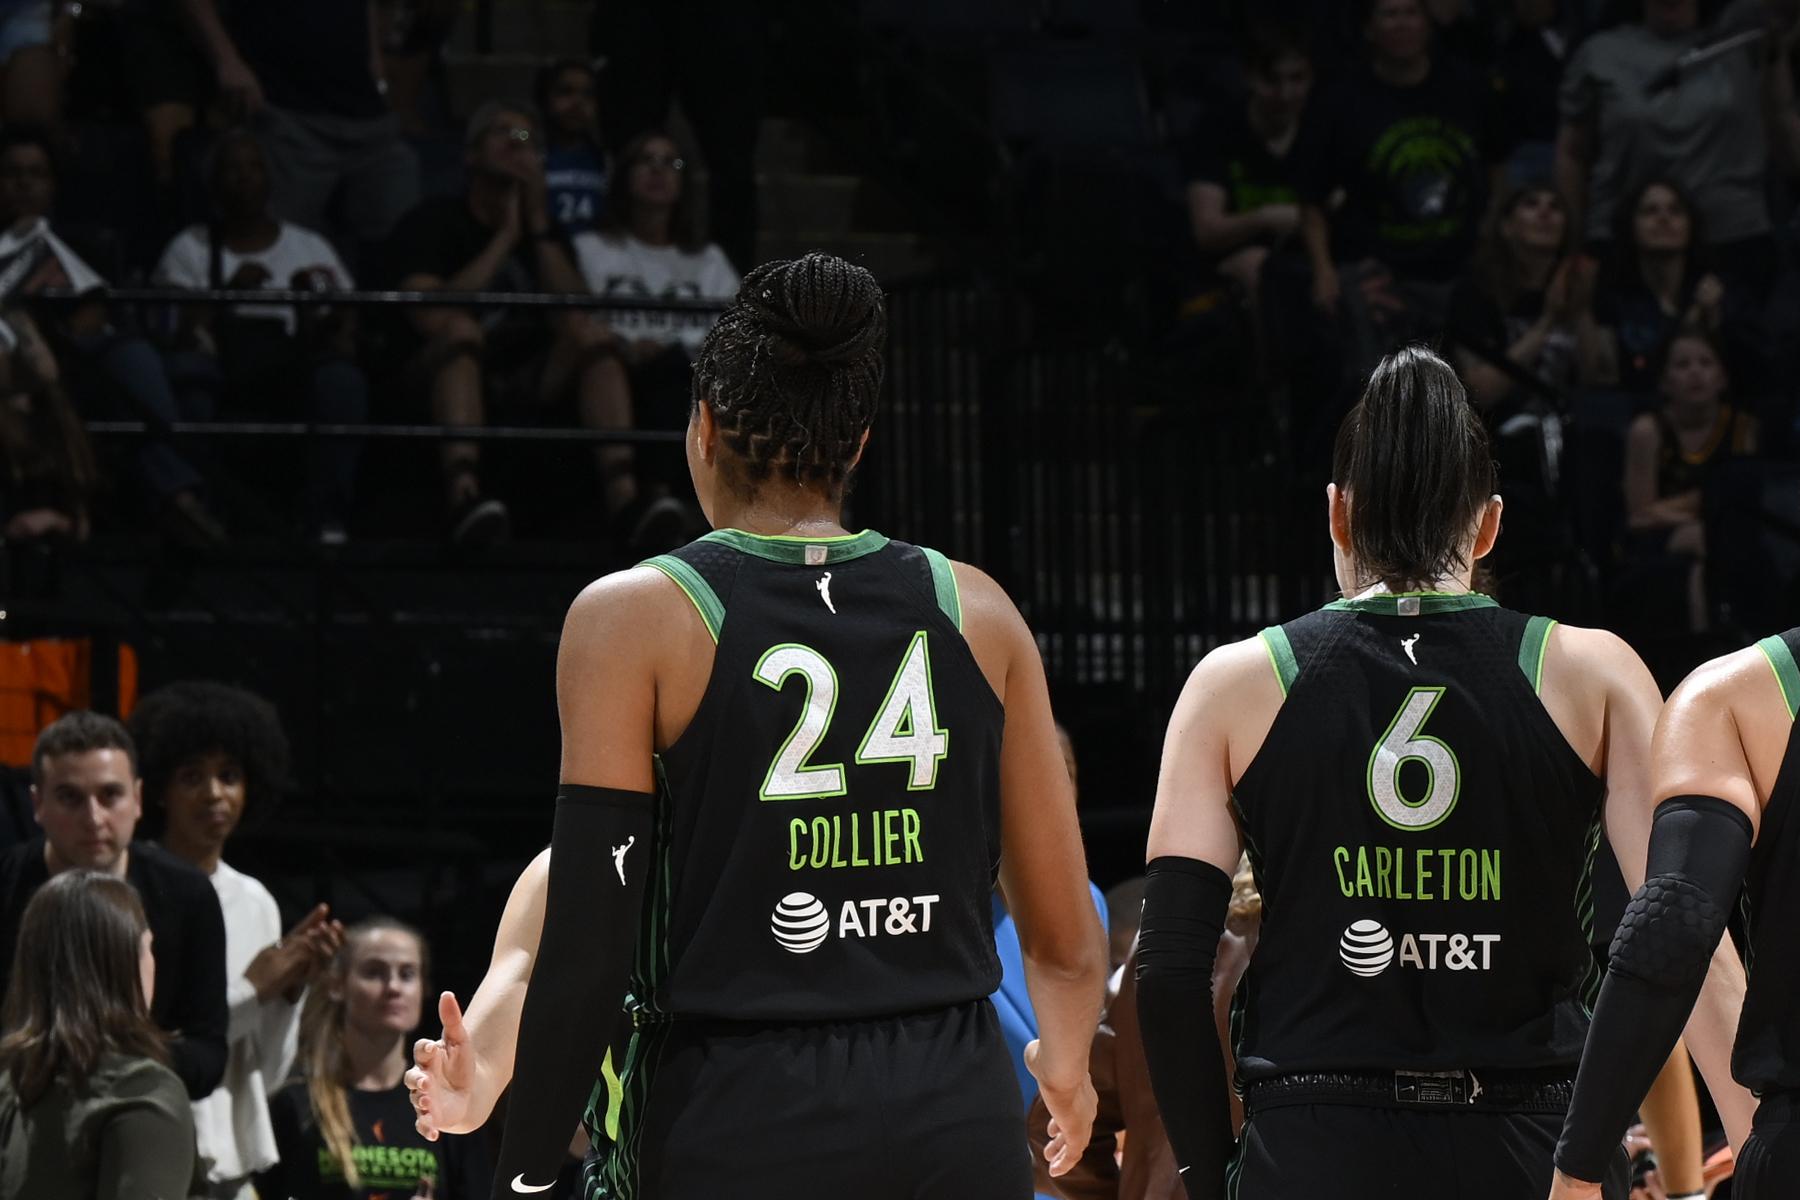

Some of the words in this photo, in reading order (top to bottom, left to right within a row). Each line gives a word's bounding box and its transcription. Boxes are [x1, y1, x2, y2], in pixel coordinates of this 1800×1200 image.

[753, 631, 948, 801] 24
[1367, 687, 1460, 831] 6
[790, 809, 923, 870] COLLIER
[1334, 846, 1500, 900] CARLETON
[839, 895, 939, 938] AT&T
[1400, 934, 1500, 970] AT&T
